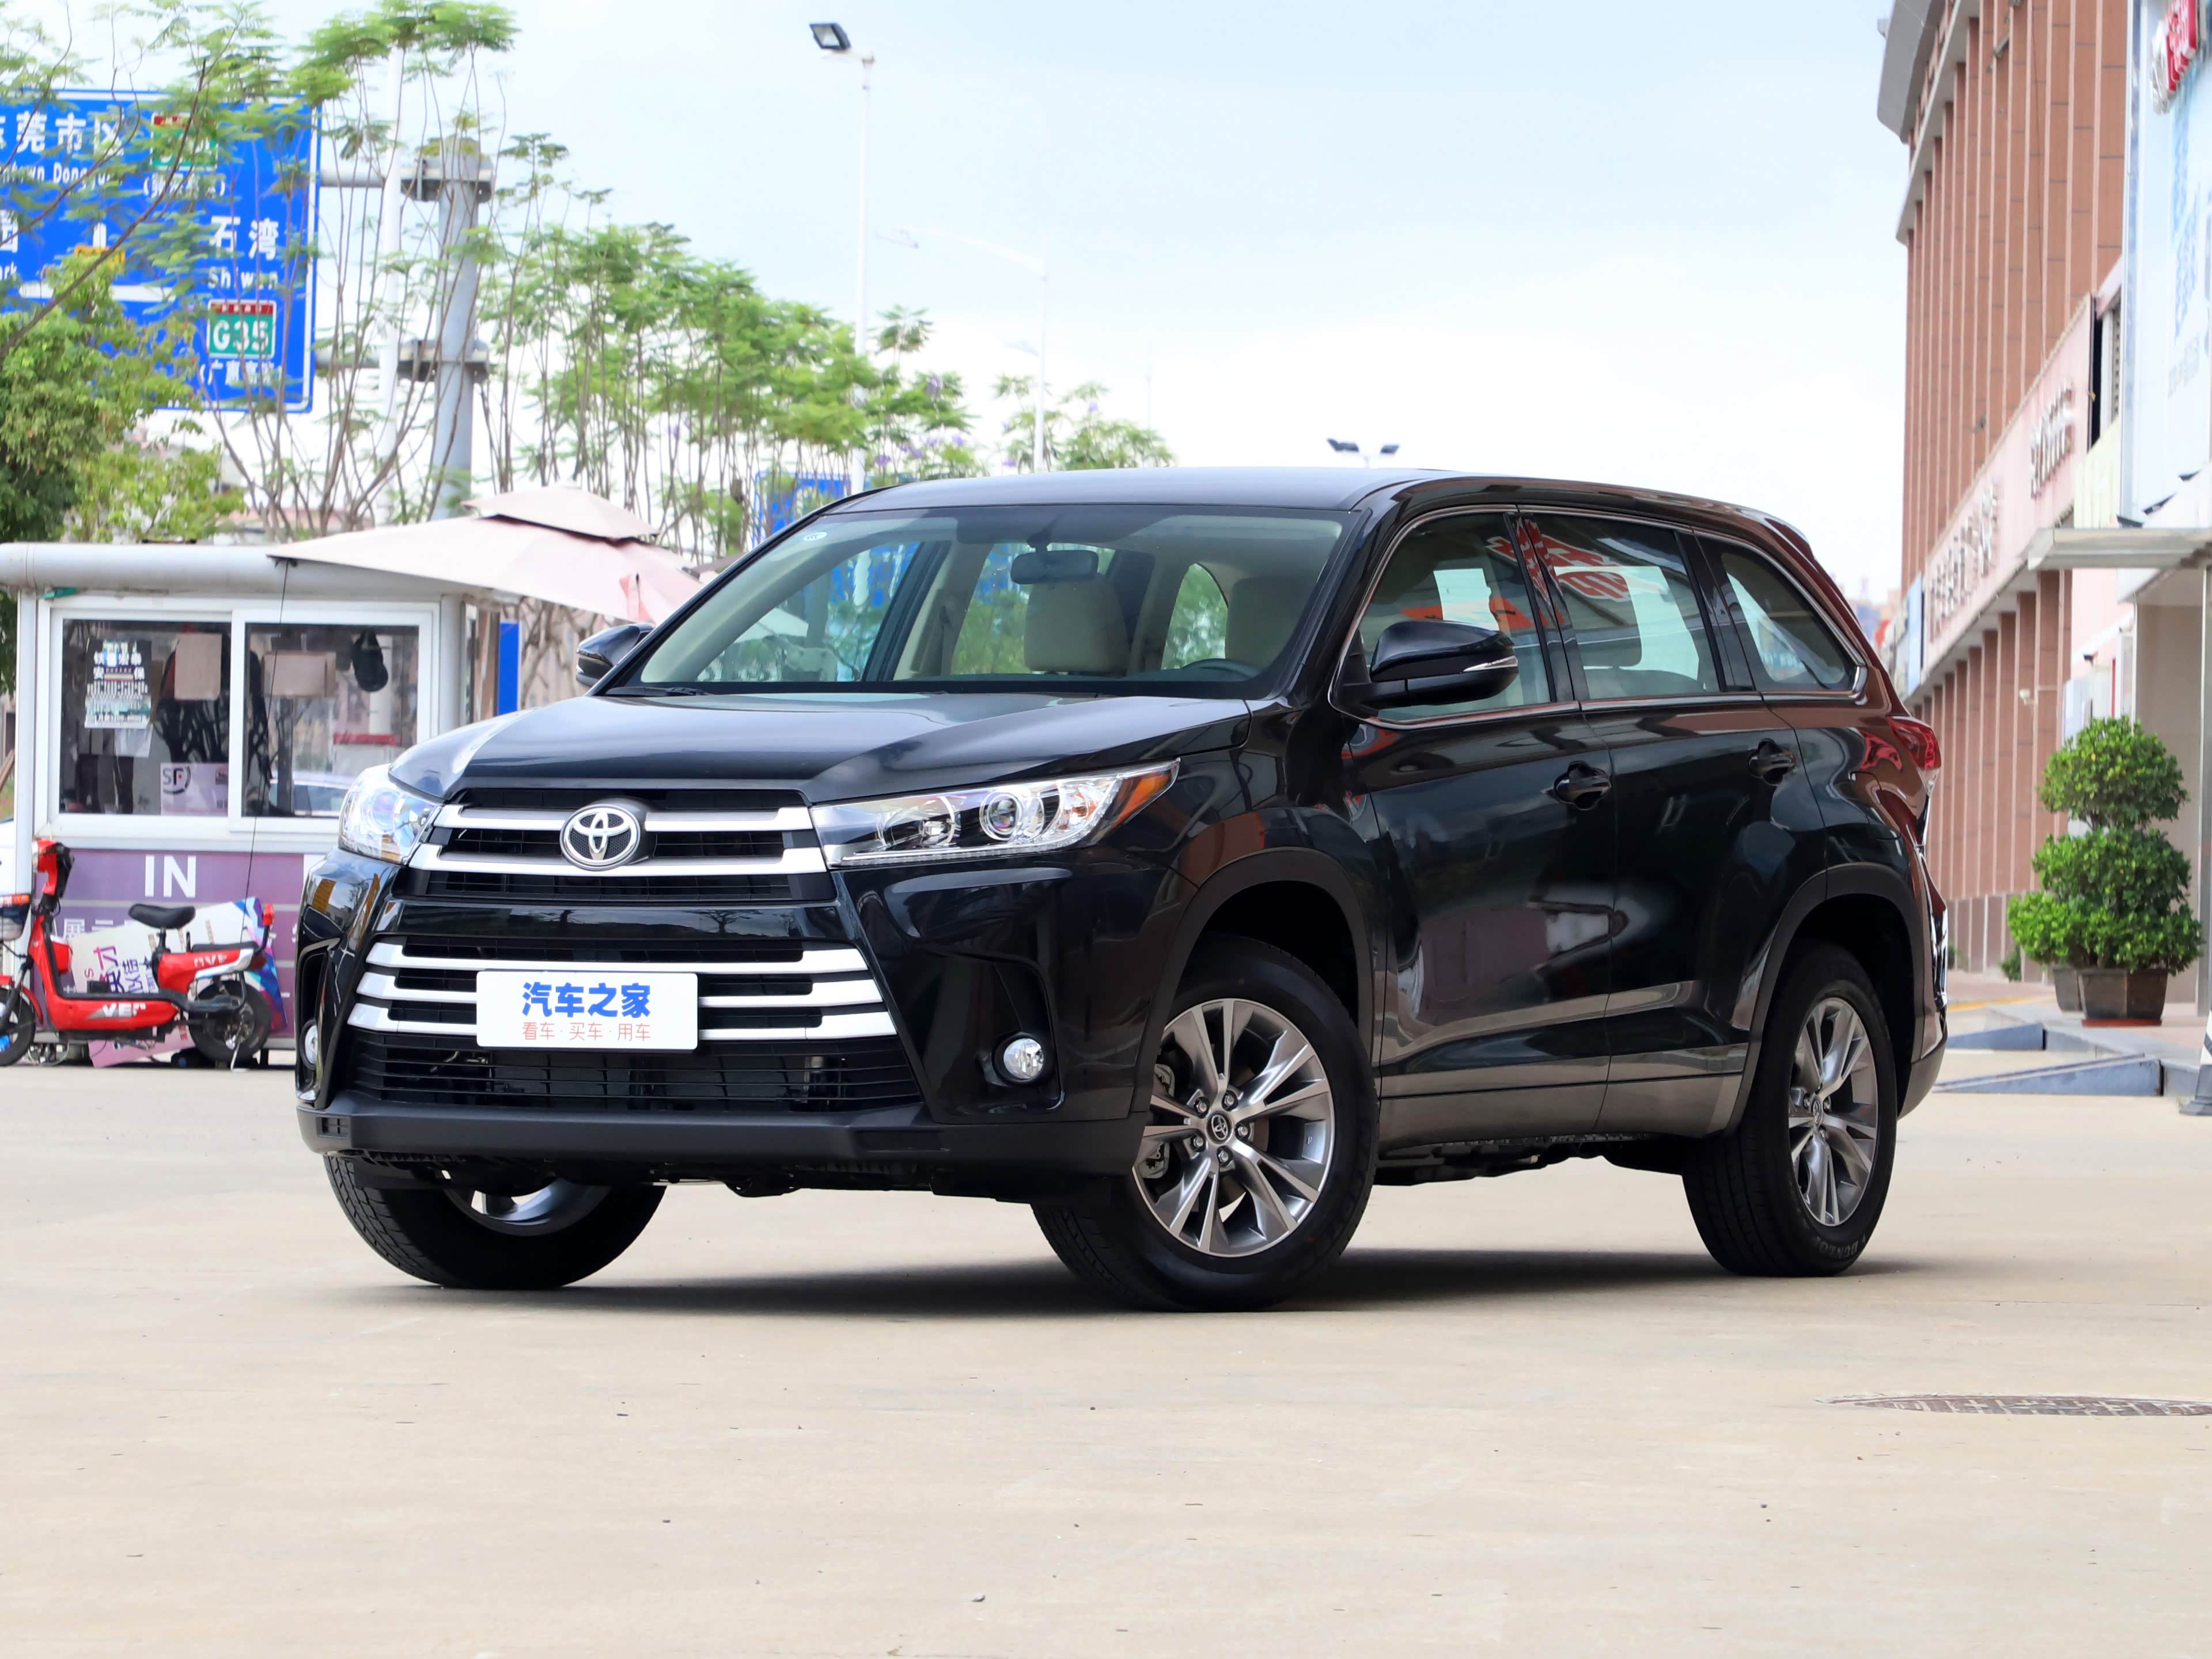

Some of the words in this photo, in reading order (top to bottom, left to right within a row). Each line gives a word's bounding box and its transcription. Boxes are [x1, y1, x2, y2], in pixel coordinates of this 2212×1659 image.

[0, 111, 124, 157] 莞市区
[209, 215, 279, 261] 石湾
[213, 320, 269, 352] G35
[145, 854, 196, 898] IN
[522, 981, 651, 1018] 汽车之家
